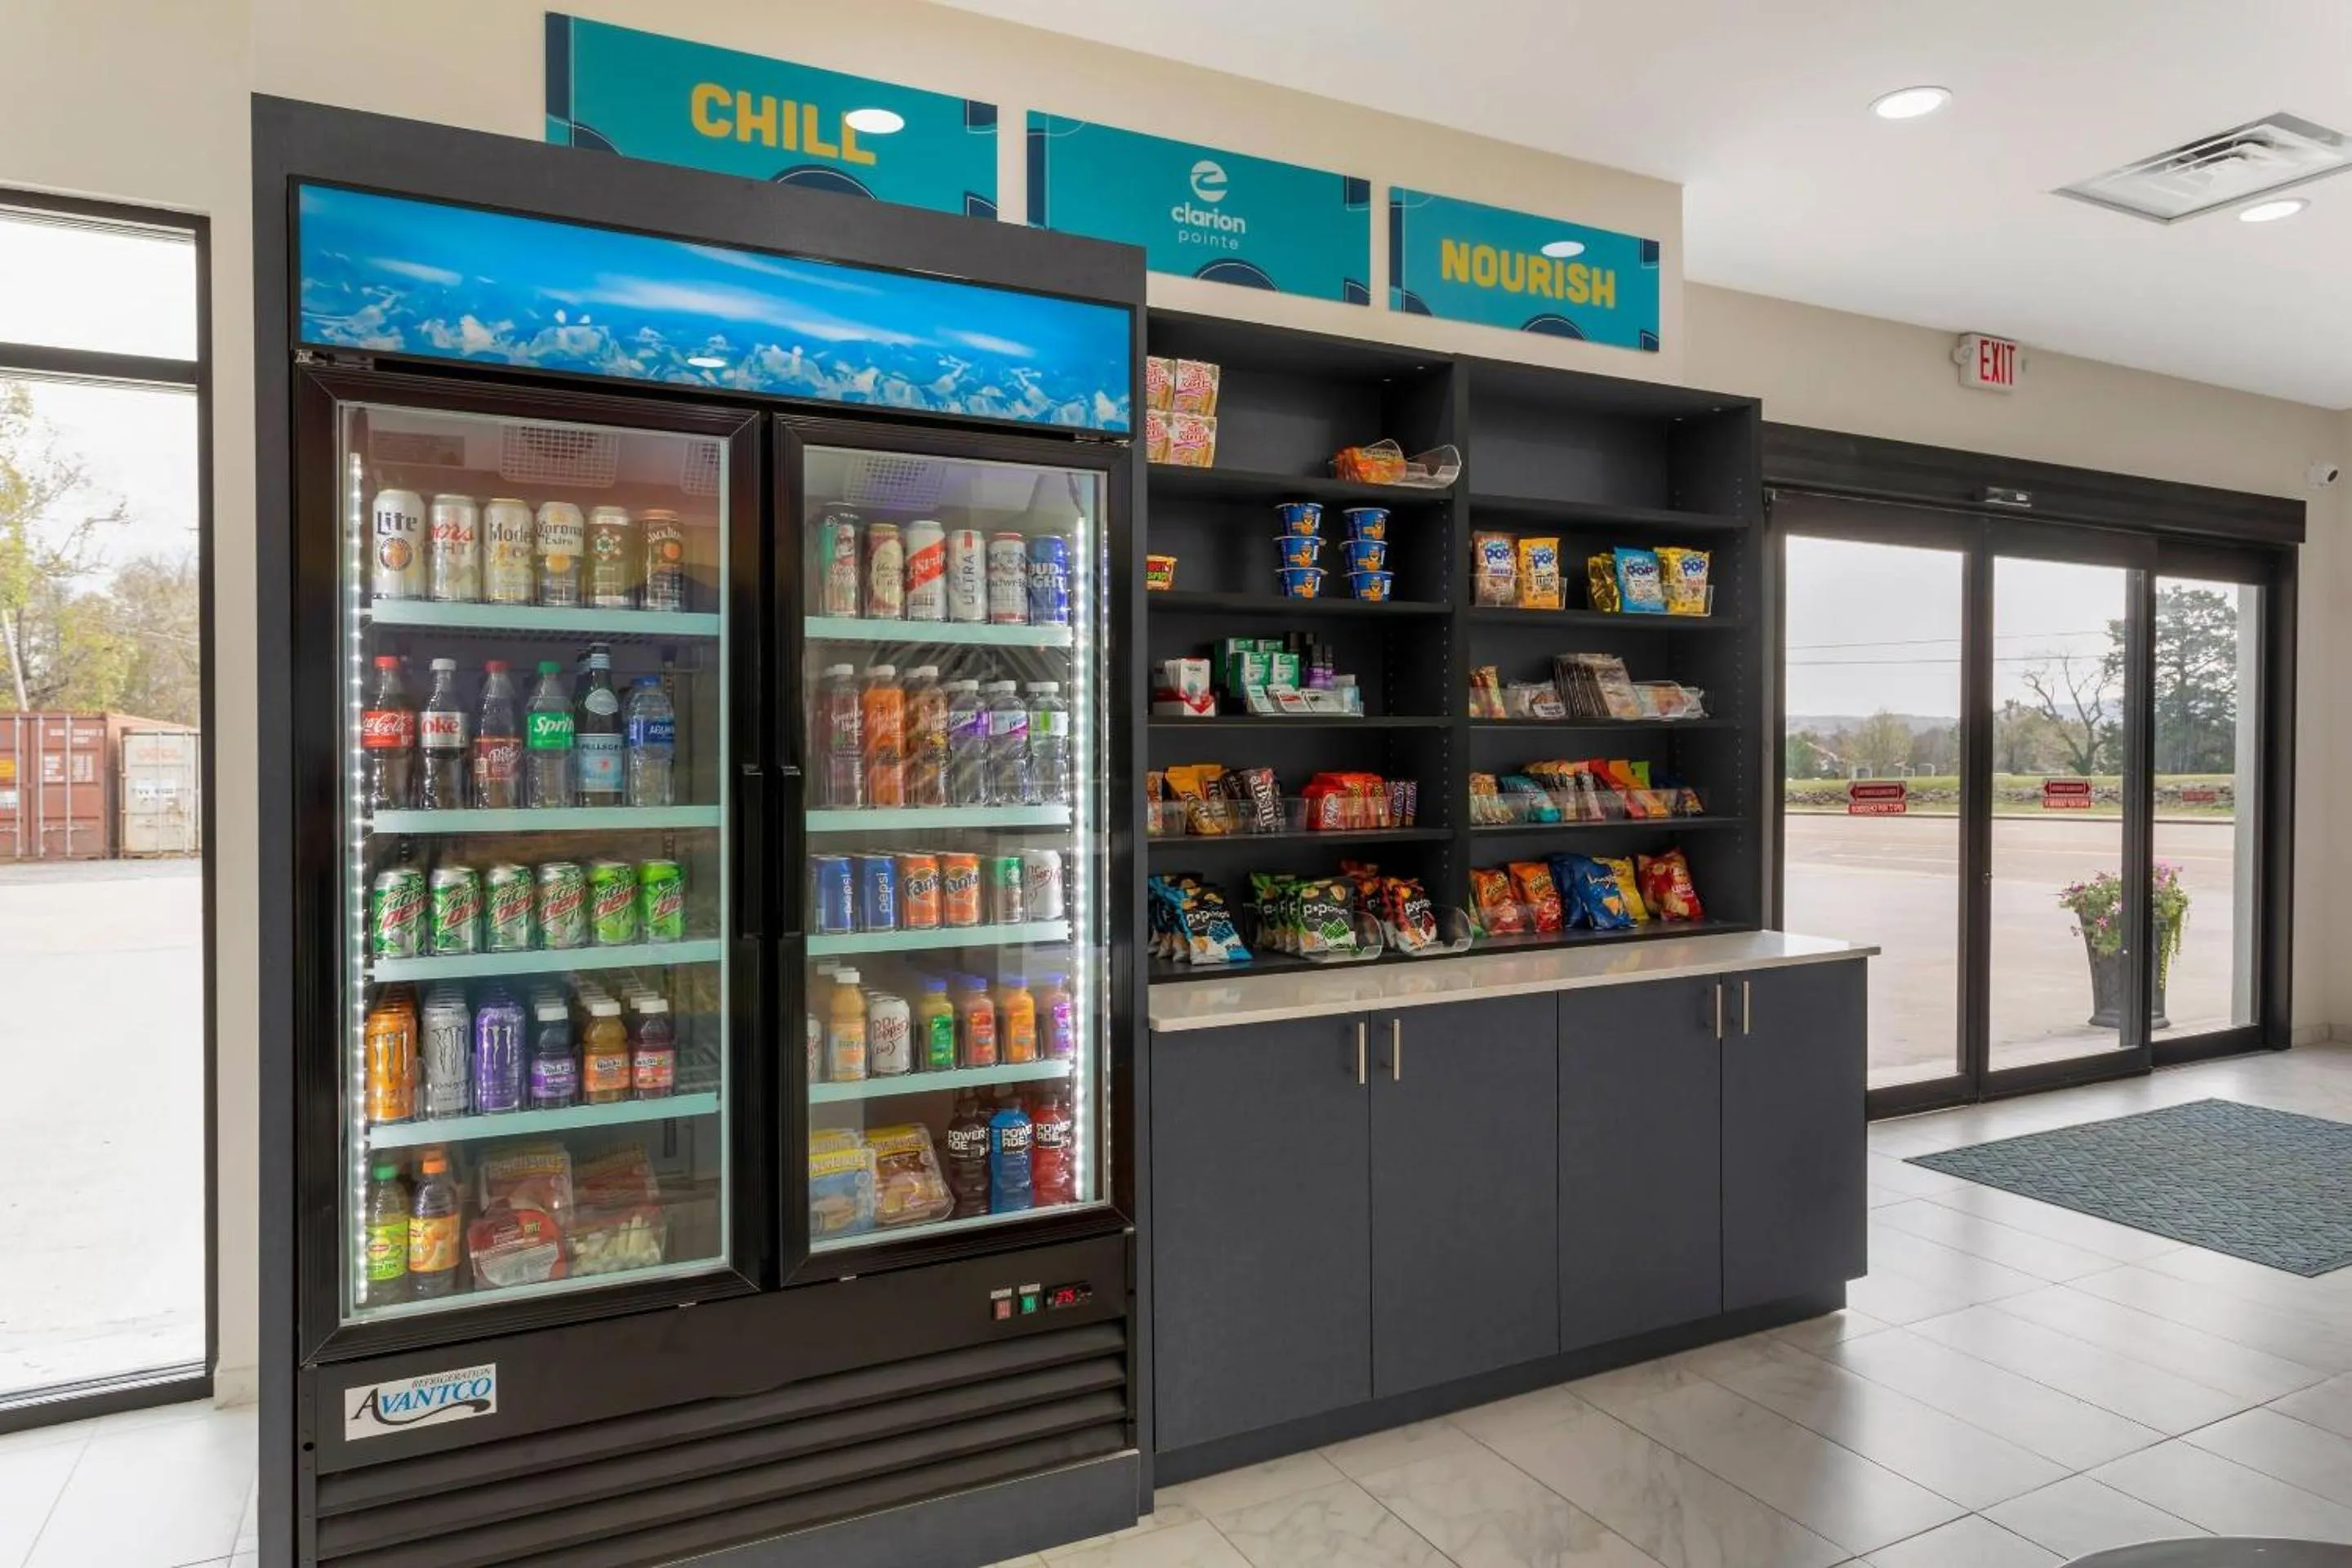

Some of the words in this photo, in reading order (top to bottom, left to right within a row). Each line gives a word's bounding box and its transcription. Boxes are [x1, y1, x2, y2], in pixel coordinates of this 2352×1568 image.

[689, 82, 877, 166] CHILL
[1170, 202, 1247, 234] clarion
[1178, 229, 1240, 251] pointe
[1441, 238, 1616, 310] NOURISH
[1980, 339, 2016, 385] EXIT
[376, 510, 418, 536] Lite
[963, 554, 975, 604] ULTRA
[875, 871, 893, 913] pepsi
[350, 1377, 492, 1423] AVANTCO
